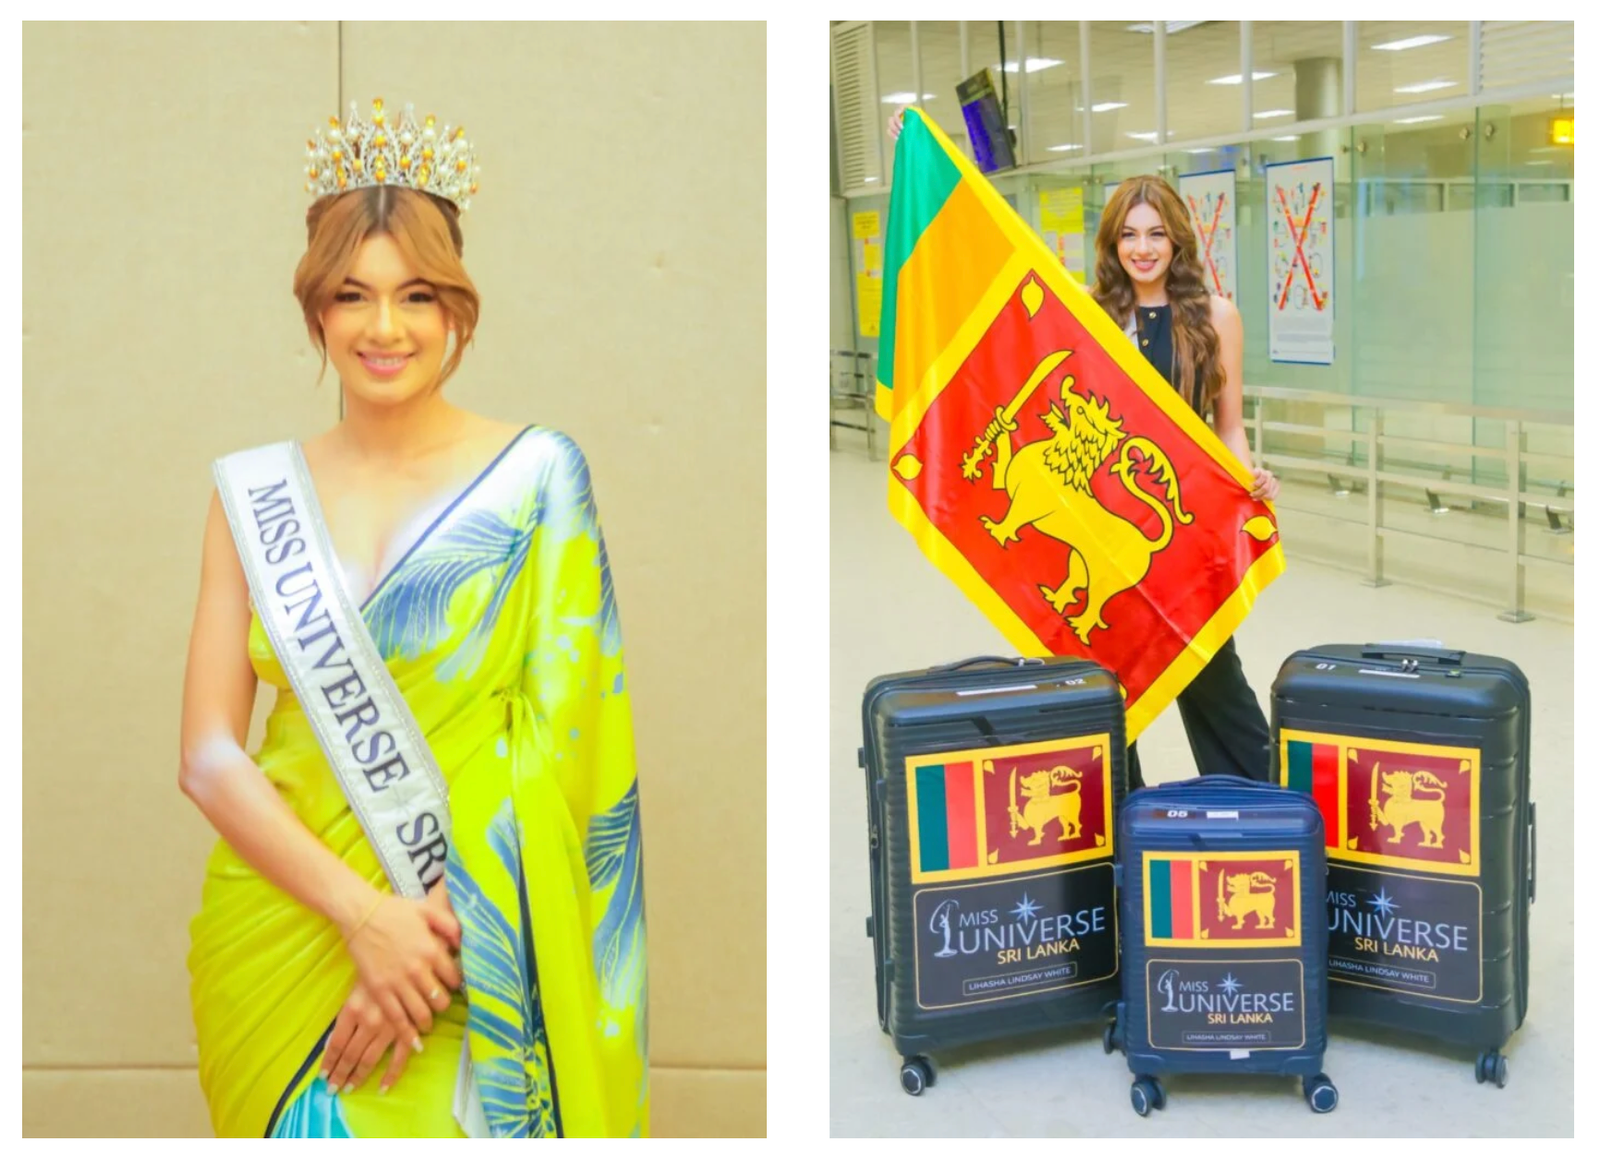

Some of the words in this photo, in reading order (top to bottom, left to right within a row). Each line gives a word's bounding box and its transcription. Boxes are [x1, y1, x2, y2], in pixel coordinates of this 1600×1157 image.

[248, 478, 306, 565] MISS
[275, 561, 411, 793] UNIVERSE
[959, 909, 999, 928] MISS
[959, 906, 1105, 955] UNIVERSE
[997, 947, 1021, 965] SRI
[1027, 937, 1080, 960] LANKA
[1355, 937, 1378, 952] SRI
[1384, 943, 1439, 963] LANKA
[968, 978, 1006, 991] LIHASHA
[1007, 972, 1042, 985] LINDSAY
[1044, 966, 1071, 978] WHITE
[1179, 981, 1209, 992] MISS
[1365, 966, 1399, 978] LINDSAY
[1401, 972, 1430, 983] WHITE
[1179, 993, 1294, 1013] UNIVERSE
[1208, 1013, 1226, 1024] SRI
[1230, 1013, 1273, 1024] LANKA
